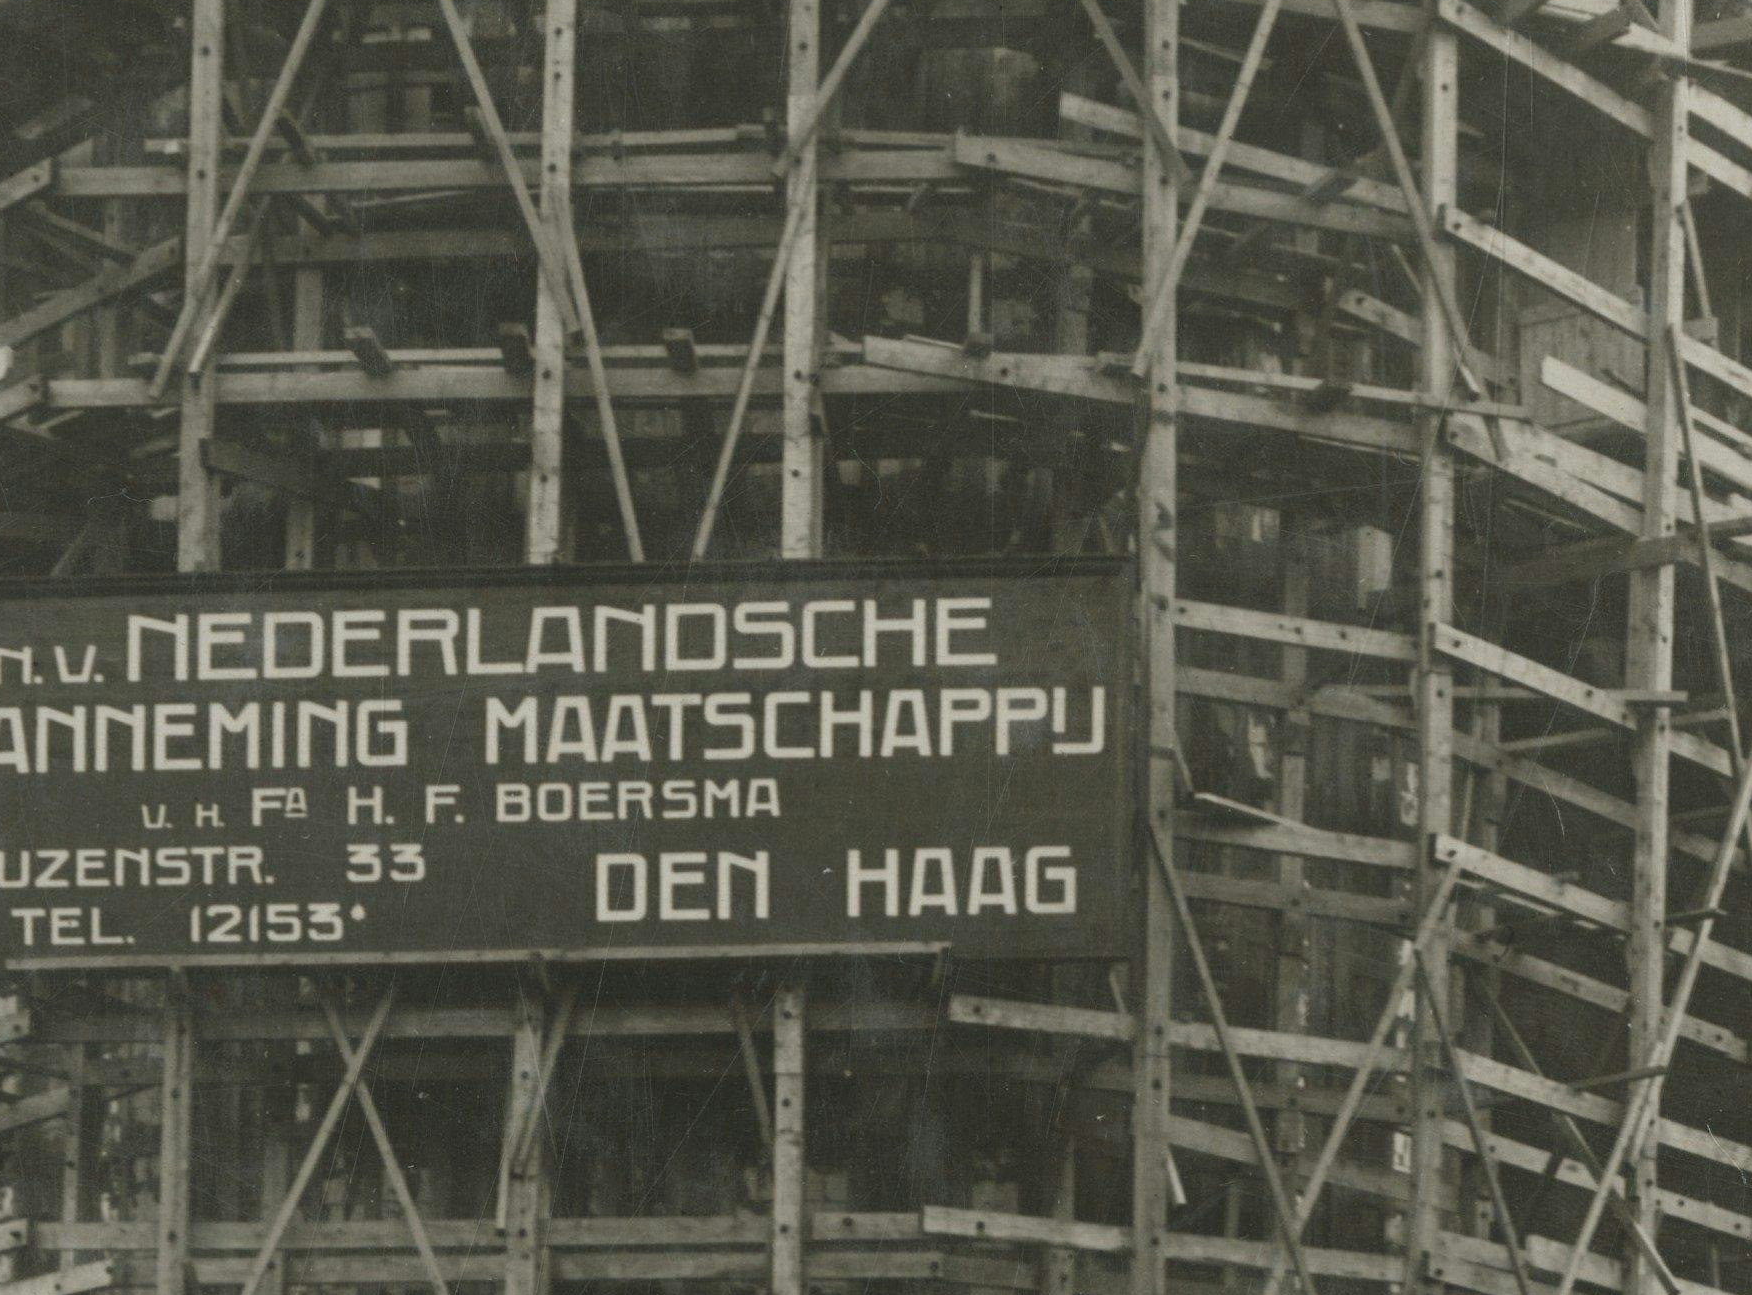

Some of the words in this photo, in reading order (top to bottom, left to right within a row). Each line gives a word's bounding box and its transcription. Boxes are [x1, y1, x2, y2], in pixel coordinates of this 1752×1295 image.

[127, 597, 998, 682] NEDERLANDSCHE
[346, 785, 395, 826] H.
[424, 784, 465, 825] F.
[495, 777, 782, 823] BOERSMA
[345, 843, 428, 883] 33
[596, 850, 770, 923] DEN
[846, 845, 1078, 919] HAAG
[10, 907, 136, 947] TEL.
